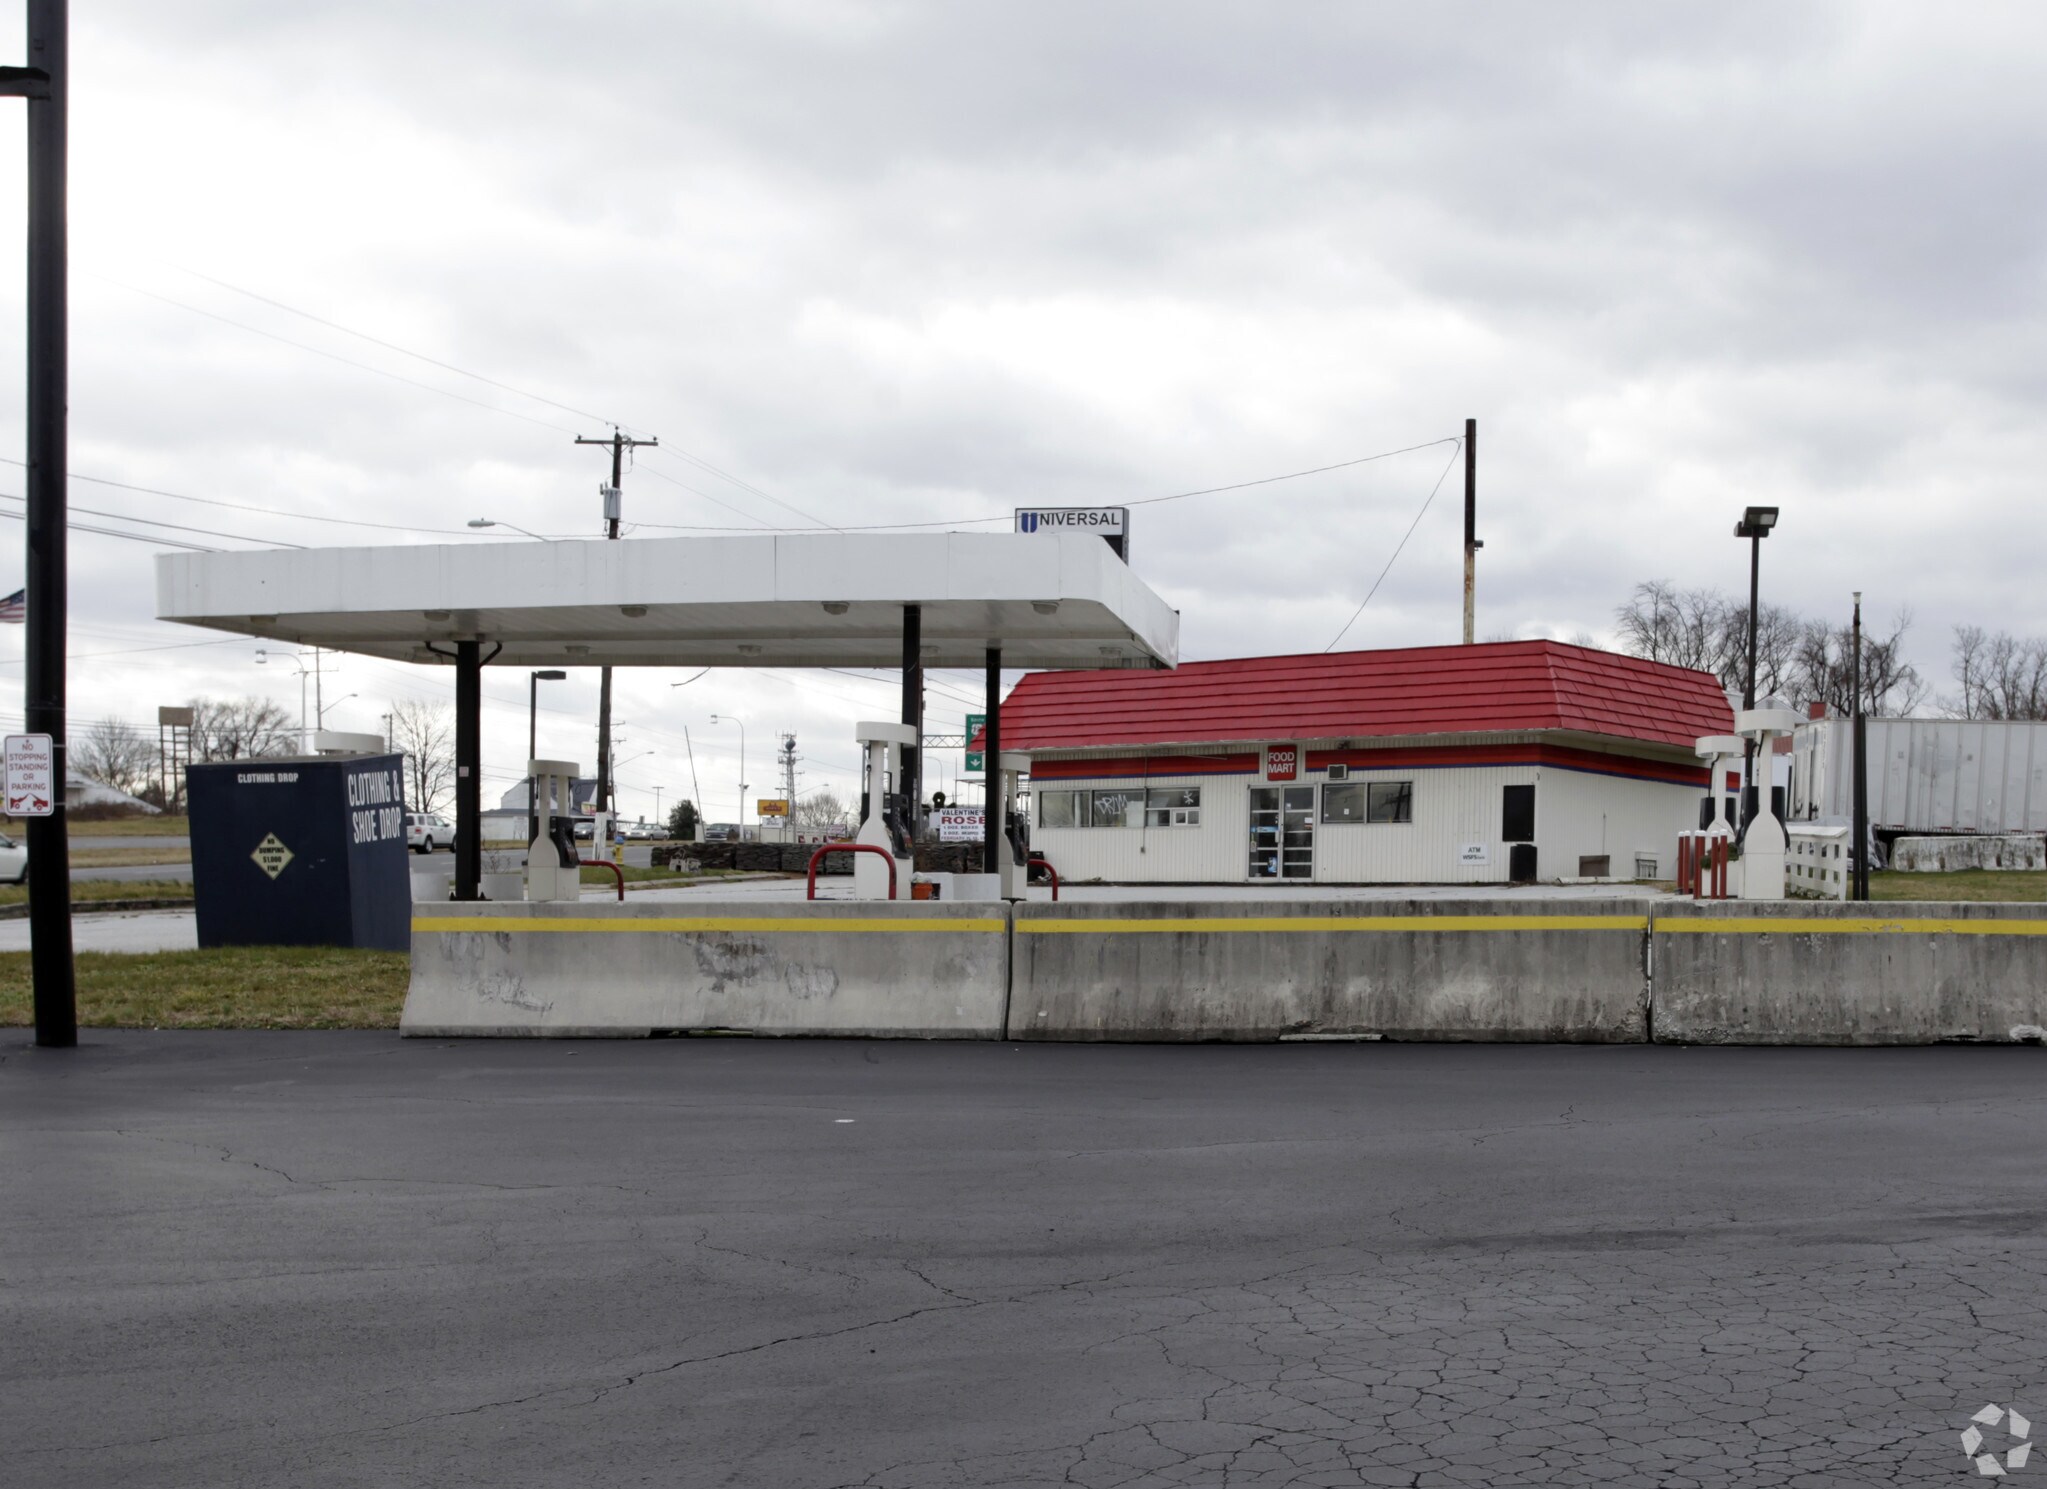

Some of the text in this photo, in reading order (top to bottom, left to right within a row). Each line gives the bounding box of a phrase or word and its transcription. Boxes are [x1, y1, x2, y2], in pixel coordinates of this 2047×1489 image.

[1021, 512, 1120, 533] UNIVERSAL
[22, 743, 33, 751] NO
[9, 753, 47, 761] STOPPING
[1269, 752, 1295, 762] FOOD
[9, 763, 48, 771] STANDING
[1268, 763, 1294, 773] MART
[22, 773, 34, 781] OR
[237, 773, 299, 783] CLOTHING DROP
[11, 783, 46, 791] PARKING
[347, 770, 401, 807] CLOTHING &
[352, 806, 401, 844] SHOE DROP
